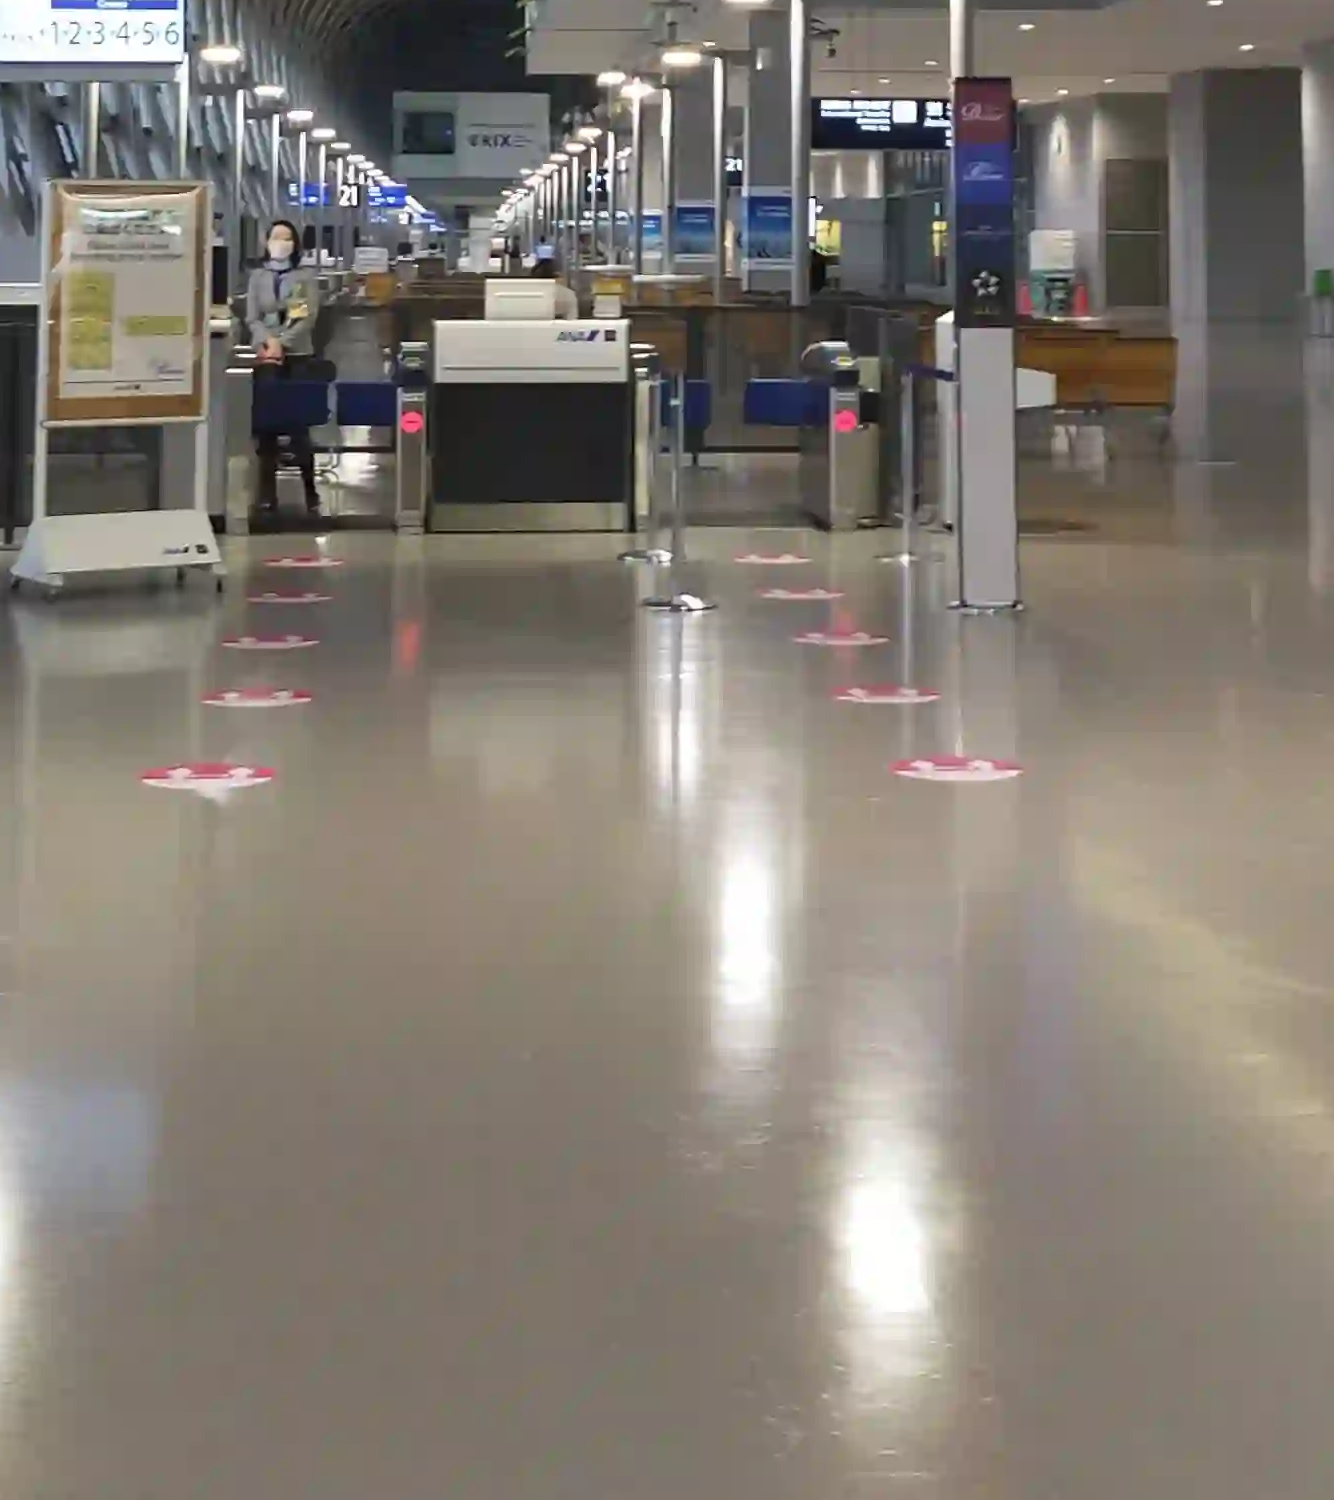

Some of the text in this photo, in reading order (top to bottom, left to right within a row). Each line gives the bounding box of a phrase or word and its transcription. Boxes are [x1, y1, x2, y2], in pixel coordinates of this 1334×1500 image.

[68, 21, 82, 45] 2
[92, 21, 106, 45] 3
[115, 21, 130, 45] 4
[142, 21, 155, 45] 5
[164, 21, 180, 45] 6
[339, 185, 358, 206] 21
